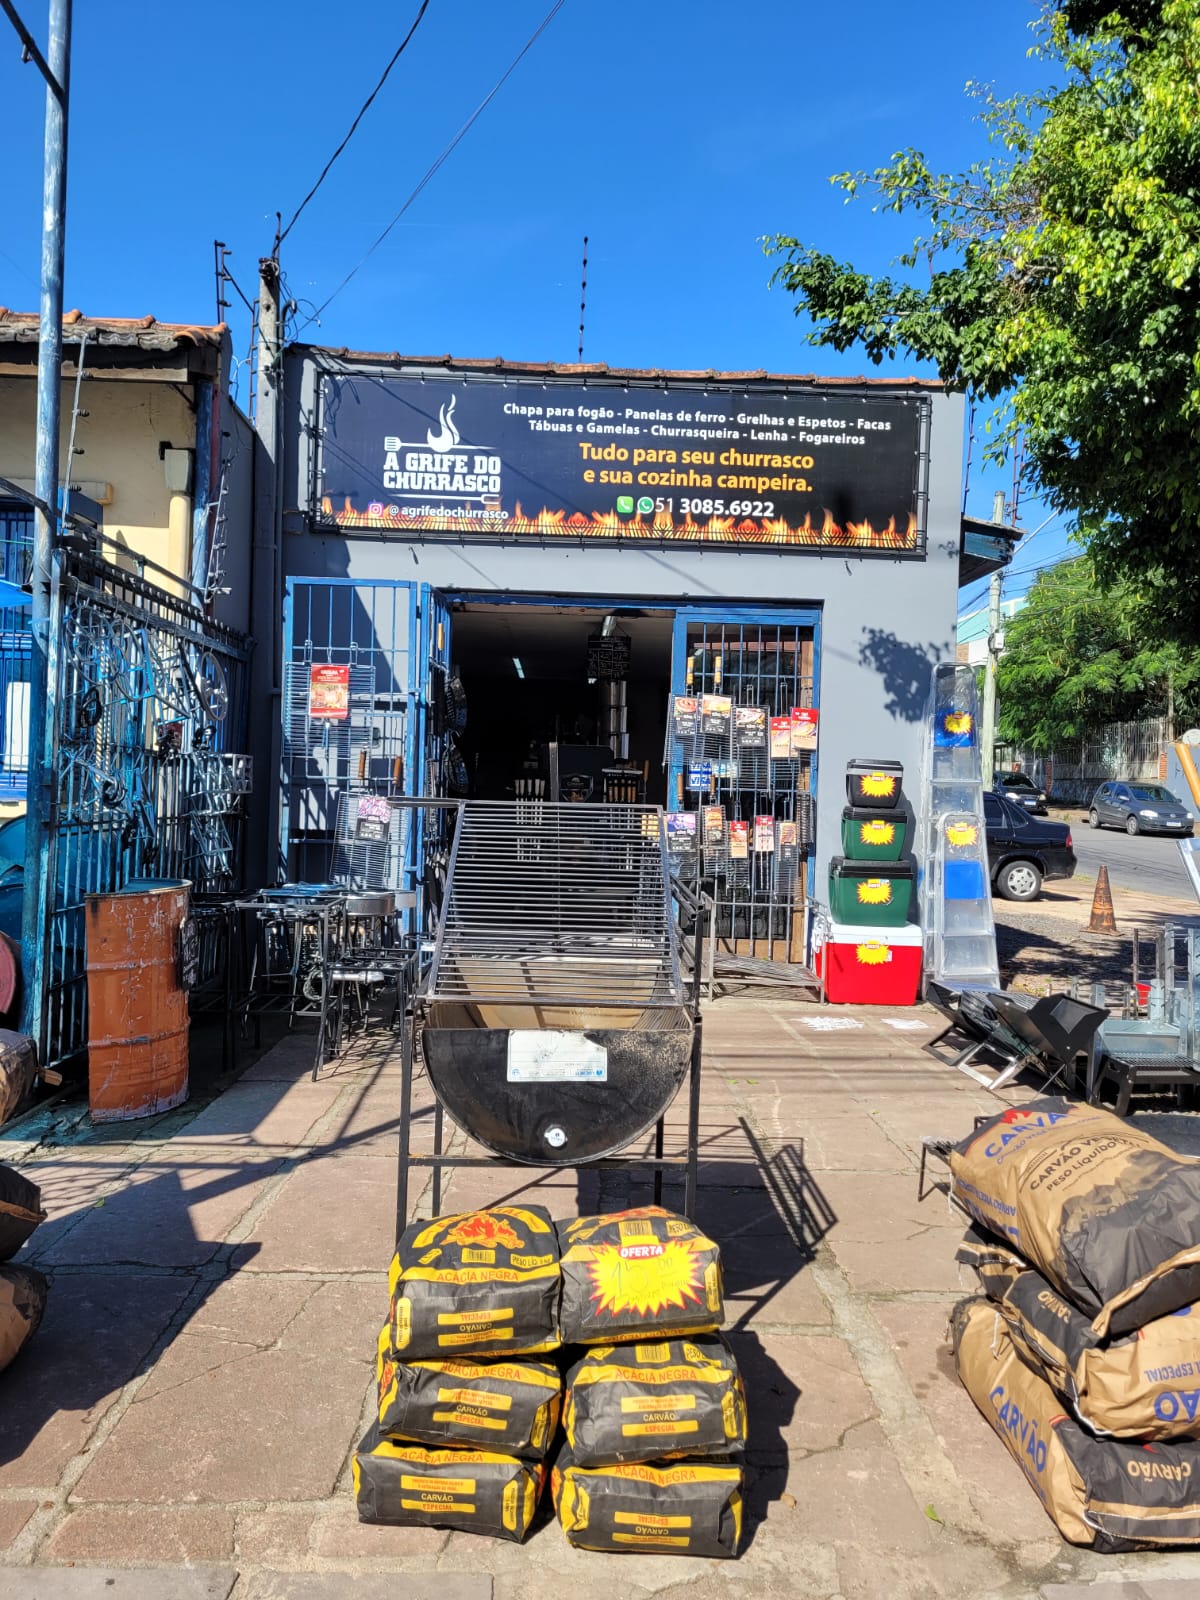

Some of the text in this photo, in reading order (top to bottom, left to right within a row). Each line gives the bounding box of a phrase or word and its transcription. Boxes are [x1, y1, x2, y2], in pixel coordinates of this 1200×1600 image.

[503, 403, 543, 420] Chapa
[546, 407, 575, 420] para
[577, 406, 614, 422] fogão
[625, 408, 673, 421] Panelas
[676, 411, 691, 422] de
[695, 411, 726, 424] ferro
[737, 413, 784, 427] Grelhas
[787, 417, 795, 426] e
[798, 416, 846, 431] Espetos
[857, 418, 891, 430] Facas
[529, 420, 573, 433] Tábuas
[575, 423, 584, 433] e
[587, 422, 640, 435] Gamelas
[651, 424, 739, 440] Churrasqueira
[751, 429, 788, 441] Lenha
[799, 431, 865, 445] Fogareiros
[384, 452, 501, 475] A GRIFE DO
[579, 442, 814, 469] Tudo para seu churrasco
[383, 471, 501, 493] CHURRASCO
[583, 469, 813, 494] e sua cozinha campeira.
[401, 506, 509, 521] agrifedochurrasco
[655, 497, 774, 517] 51 3085.6922
[1029, 1146, 1082, 1191] CARVÃO
[1046, 1169, 1073, 1191] PESO
[1073, 1140, 1117, 1171] LÍQUIDO
[620, 1245, 663, 1258] OFERTA
[480, 1270, 519, 1282] NEGRA
[482, 1366, 521, 1380] NEGRA
[658, 1368, 697, 1383] NEGRA
[1144, 1362, 1194, 1383] ESPECIAL
[456, 1404, 488, 1417] CARVÃO
[643, 1411, 676, 1422] CARVÃO
[455, 1415, 485, 1426] ESPECIAL
[644, 1424, 676, 1433] ESPECIAL
[990, 1386, 1047, 1473] CARVÃO
[444, 1451, 484, 1463] NEGRA
[658, 1469, 697, 1485] NEGRA
[1127, 1460, 1191, 1482] CARVÃO
[420, 1492, 454, 1503] CARVÃO
[422, 1502, 454, 1512] ESPECIAL
